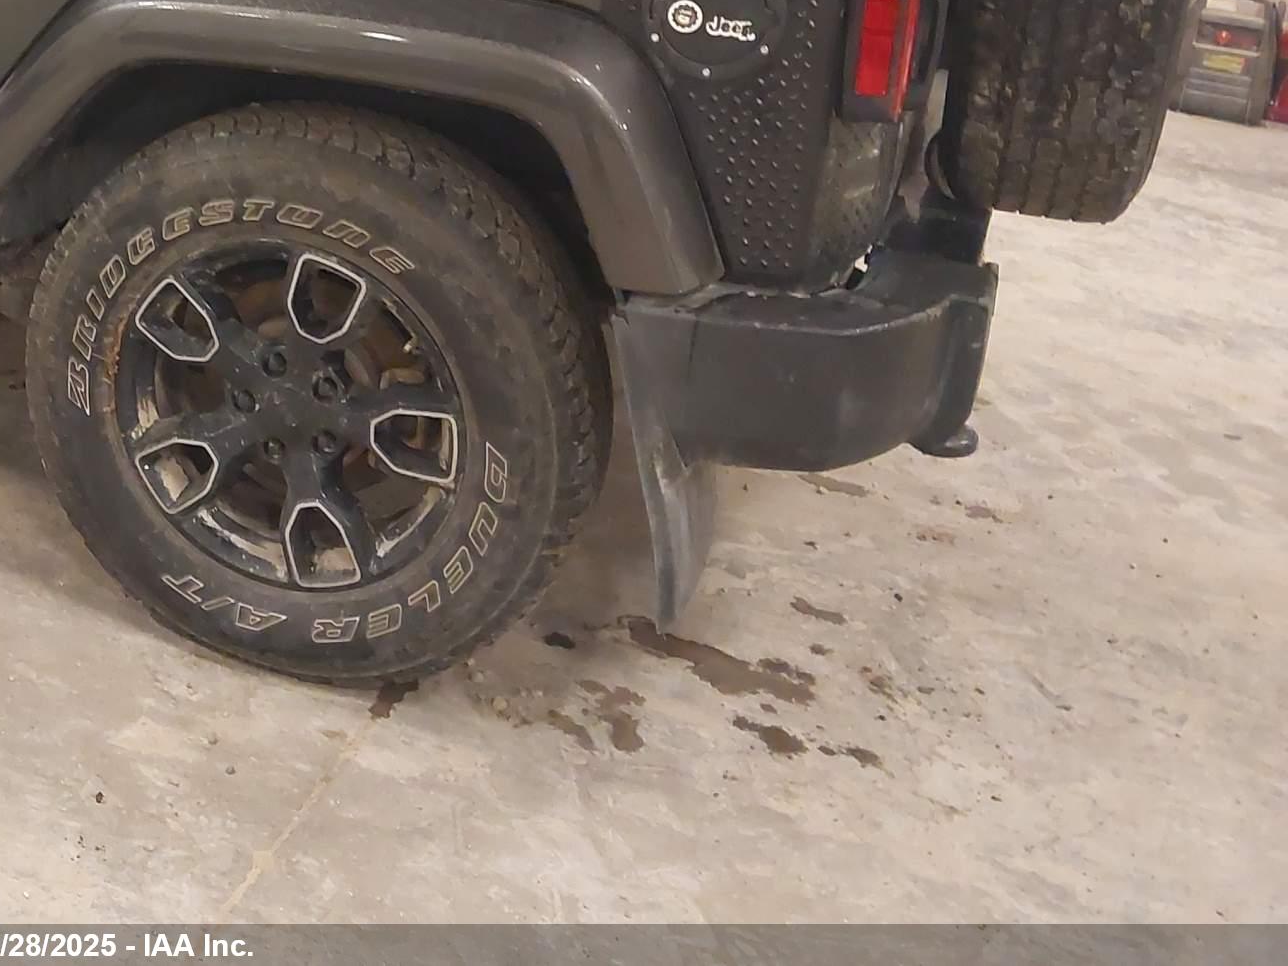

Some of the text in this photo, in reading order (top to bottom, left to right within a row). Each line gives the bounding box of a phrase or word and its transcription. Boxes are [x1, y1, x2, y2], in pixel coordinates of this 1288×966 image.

[66, 198, 415, 416] BRIDGESTONE
[161, 441, 510, 644] DUELER A/T
